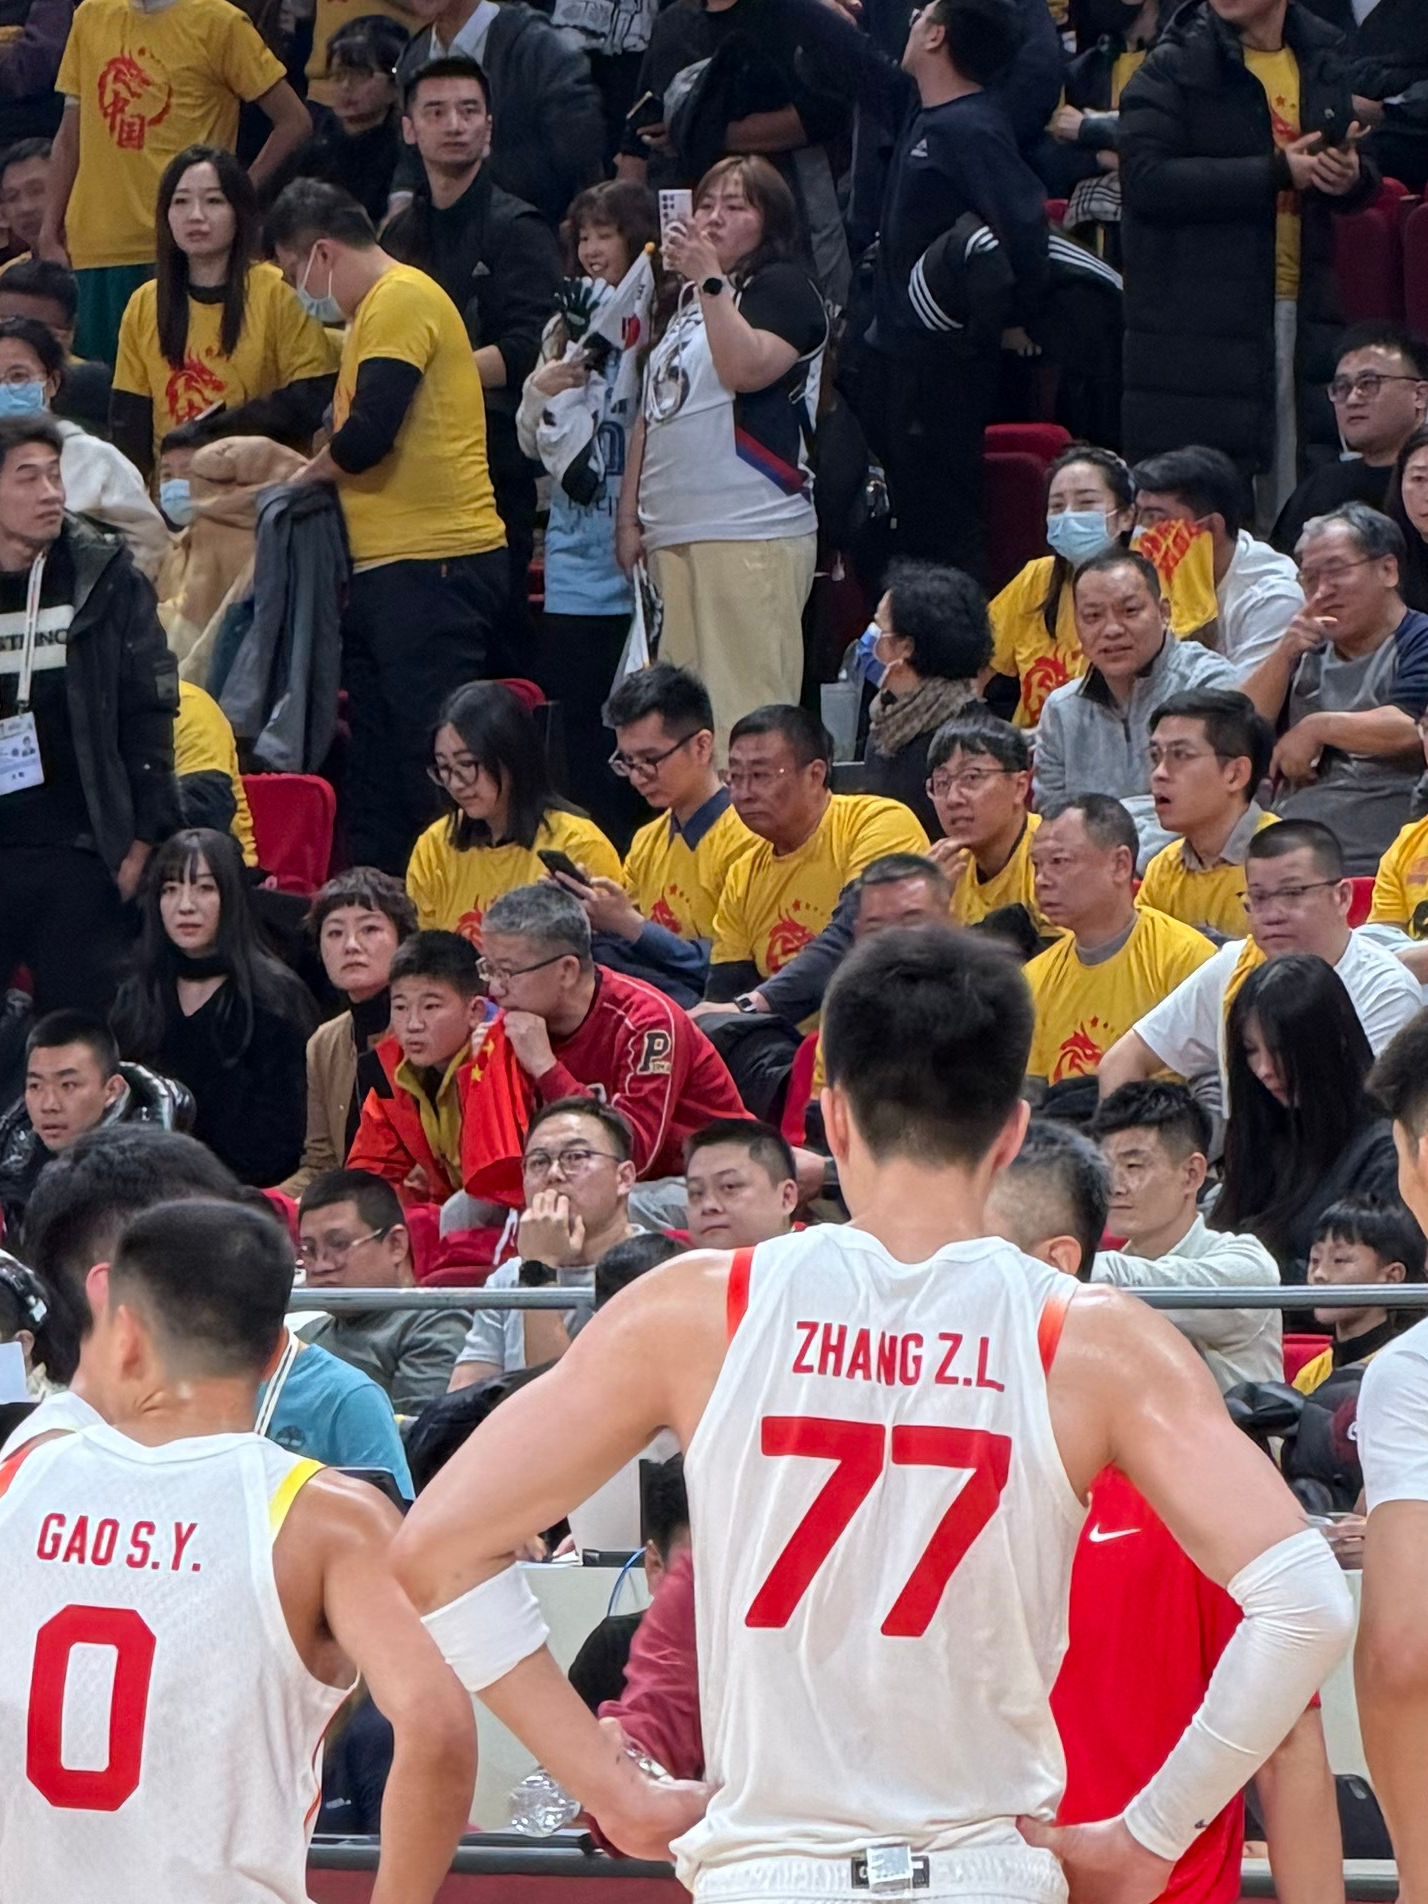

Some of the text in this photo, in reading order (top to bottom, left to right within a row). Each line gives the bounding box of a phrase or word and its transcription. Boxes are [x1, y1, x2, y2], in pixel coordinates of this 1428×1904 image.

[792, 1321, 923, 1386] ZHANG
[36, 1512, 202, 1573] GAO S.Y.
[743, 1415, 1013, 1638] 77
[26, 1603, 157, 1812] 0
